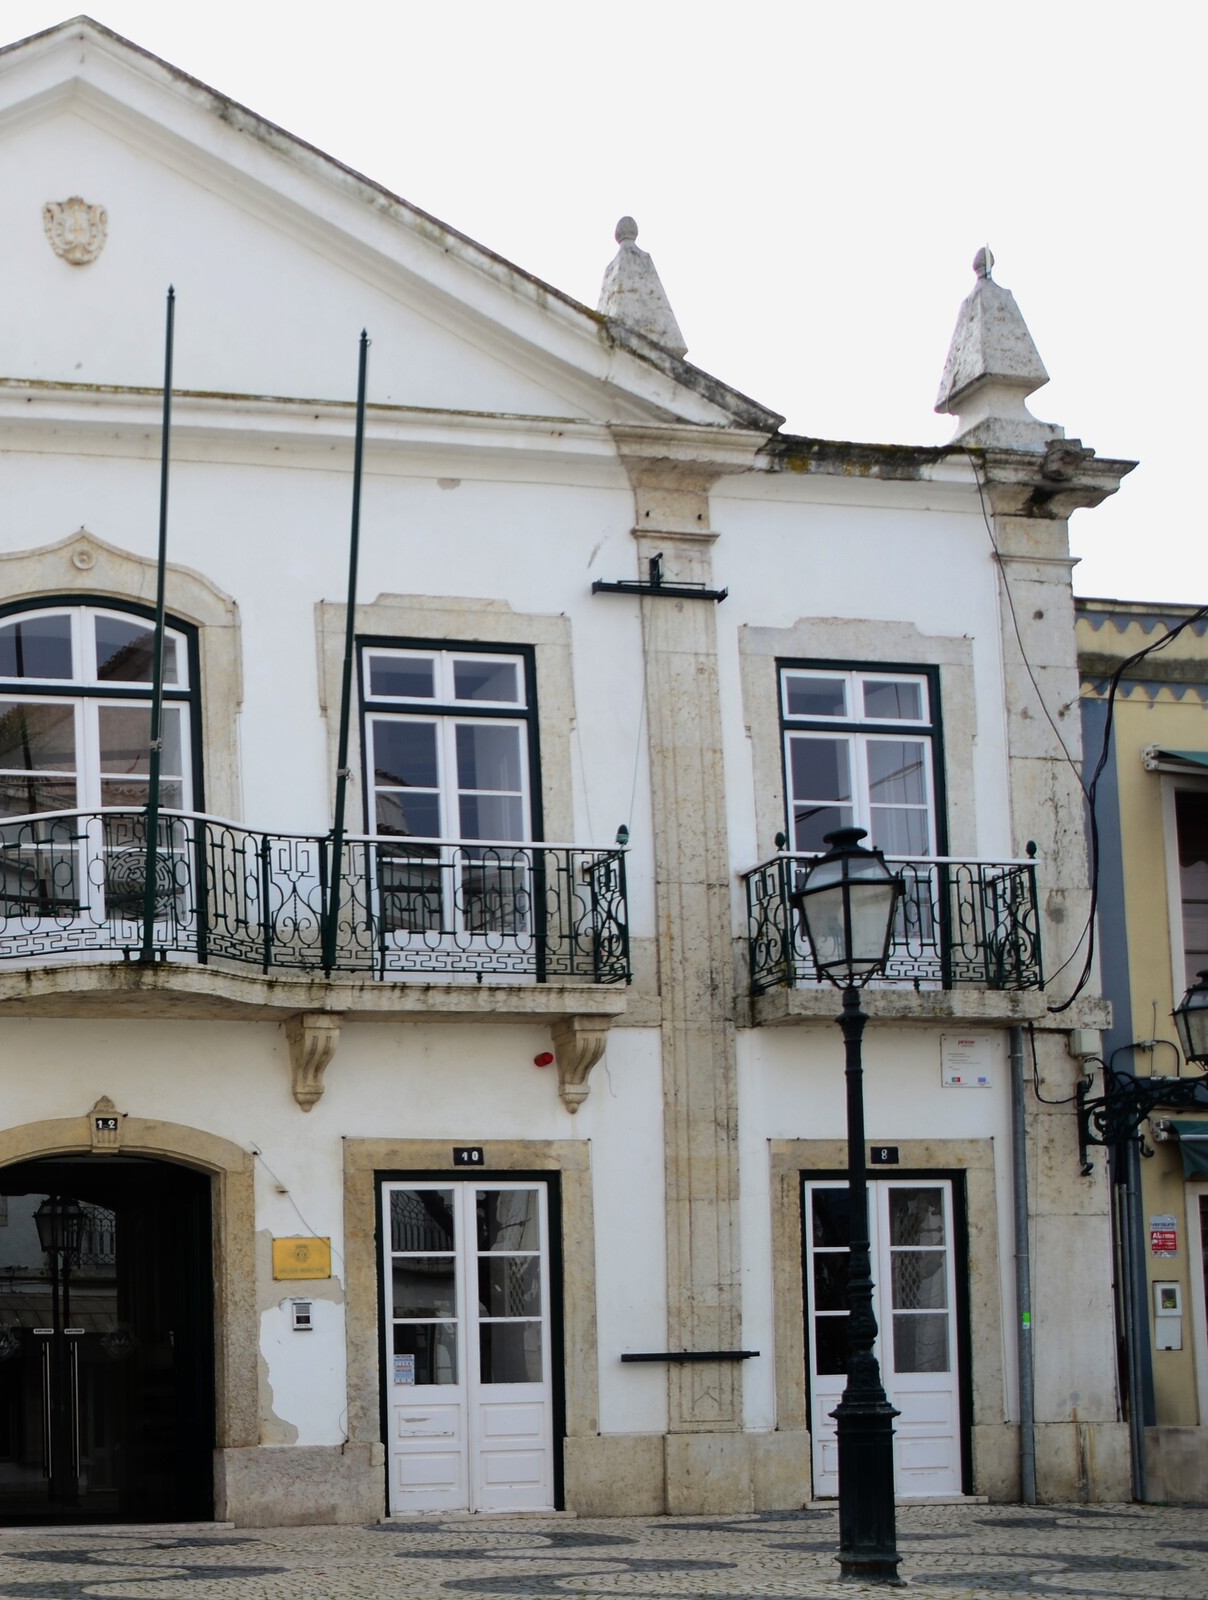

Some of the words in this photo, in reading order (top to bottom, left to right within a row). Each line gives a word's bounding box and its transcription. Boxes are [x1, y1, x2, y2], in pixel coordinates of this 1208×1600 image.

[97, 1119, 116, 1129] 12
[462, 1151, 479, 1161] 10
[881, 1149, 888, 1160] 8
